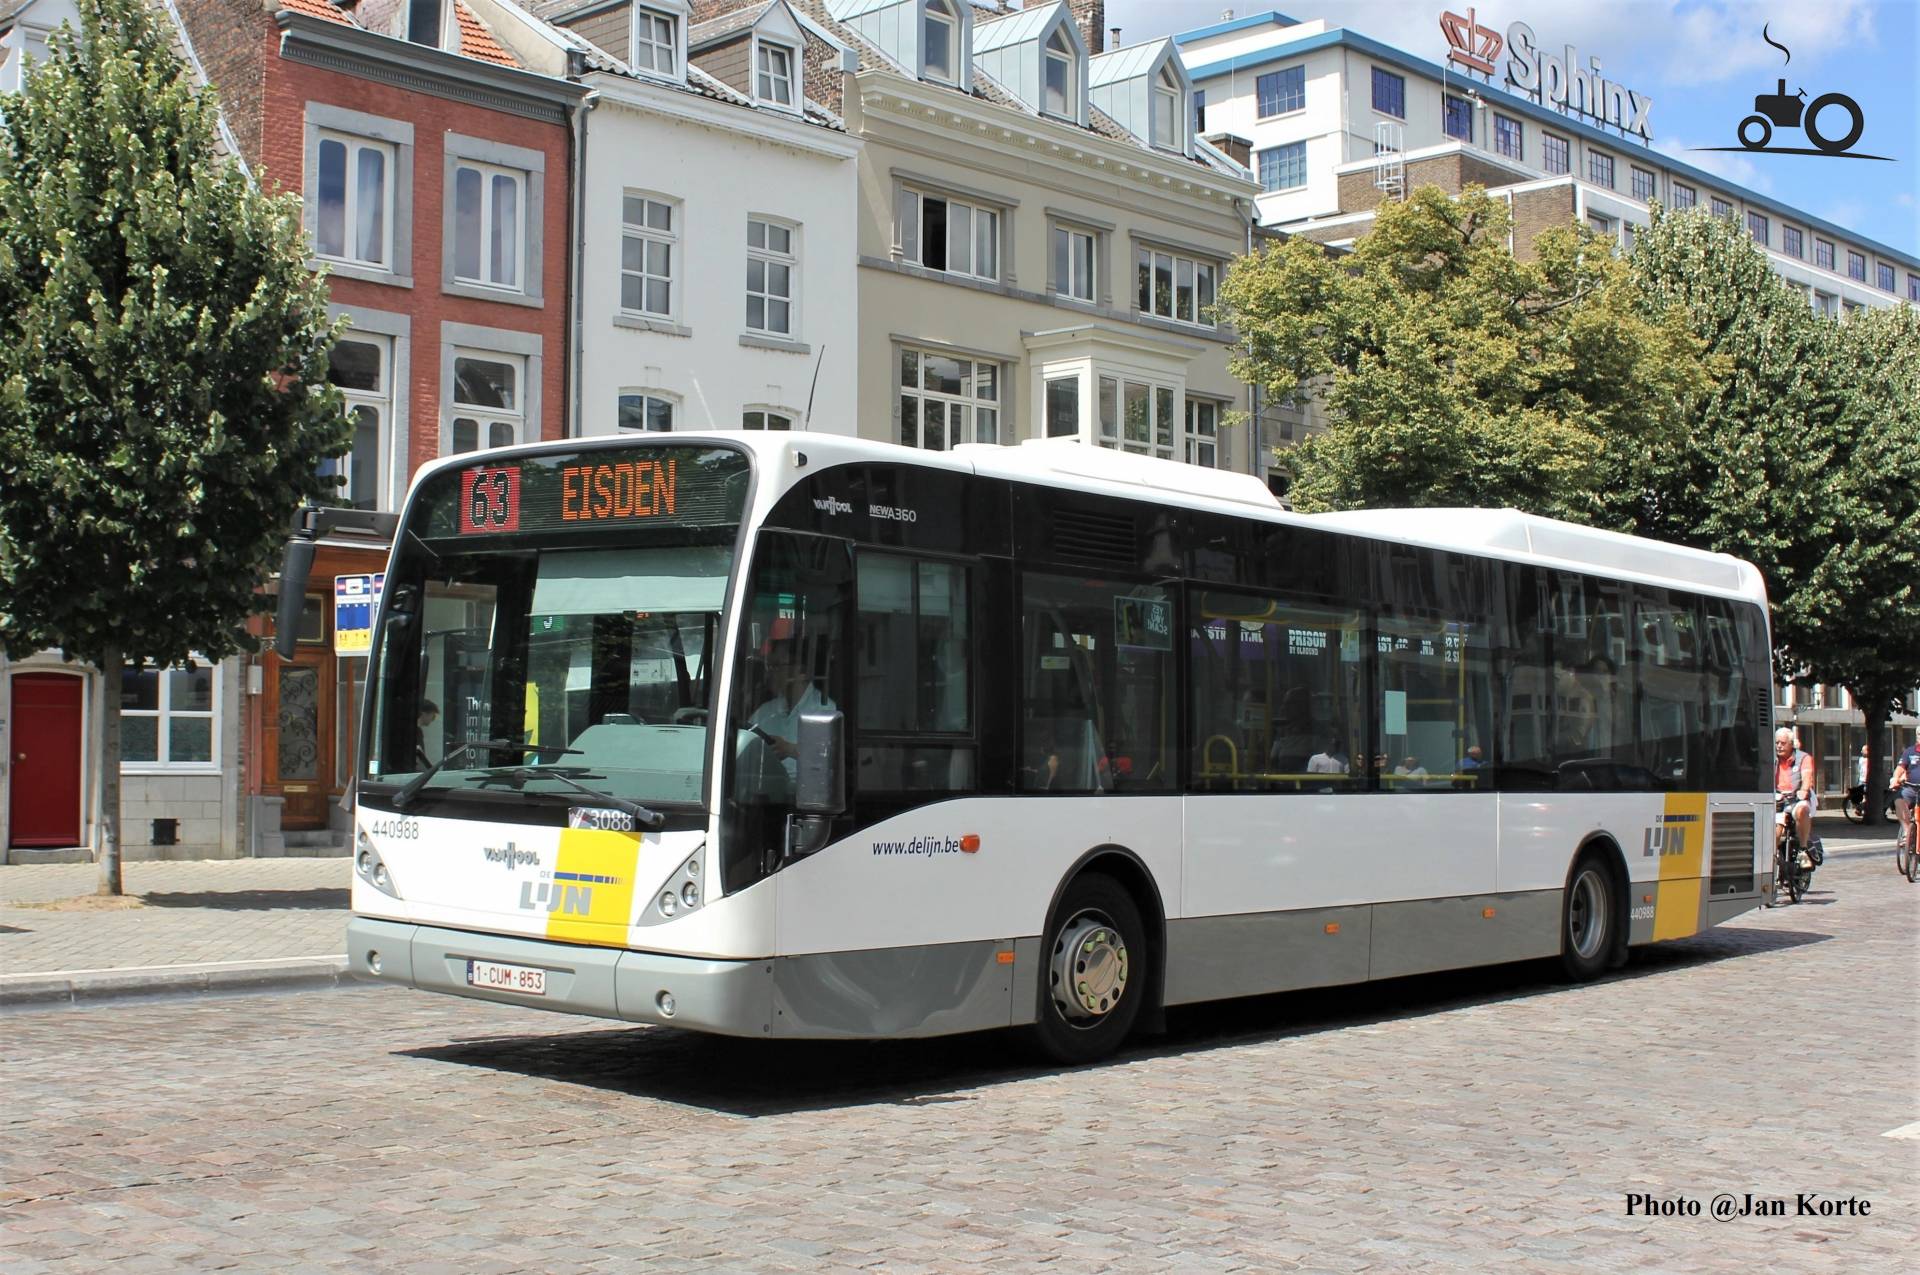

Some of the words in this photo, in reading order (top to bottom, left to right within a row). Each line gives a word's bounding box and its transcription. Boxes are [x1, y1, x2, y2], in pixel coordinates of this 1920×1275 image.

[1506, 21, 1654, 140] Sphinx
[470, 471, 511, 528] 63
[562, 460, 676, 521] EISDEN
[1288, 629, 1327, 648] PRISON
[372, 820, 419, 840] 440988
[590, 809, 632, 832] 3088
[872, 835, 959, 857] www.delijn.be
[1630, 905, 1655, 921] 440988
